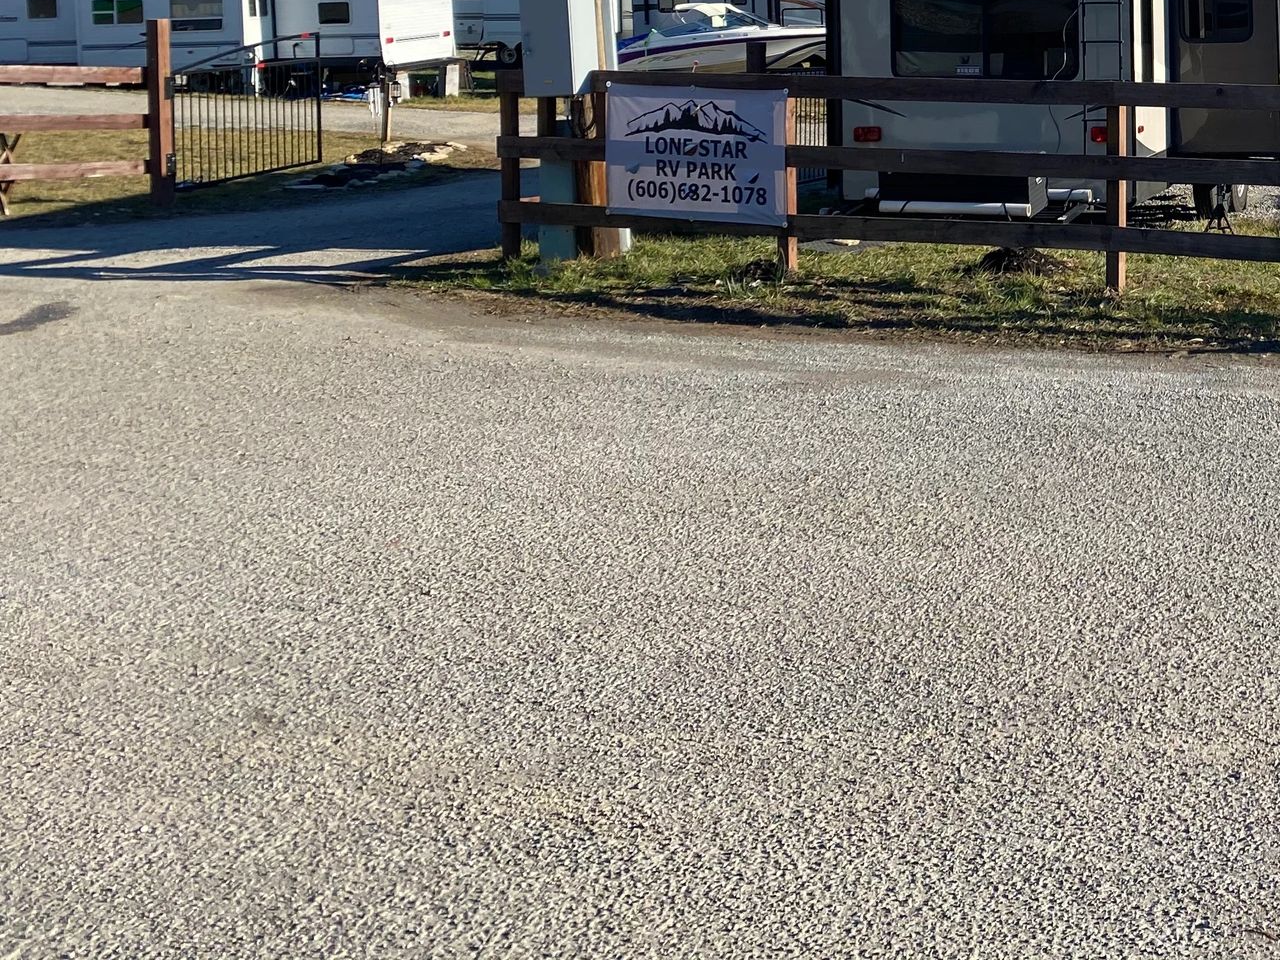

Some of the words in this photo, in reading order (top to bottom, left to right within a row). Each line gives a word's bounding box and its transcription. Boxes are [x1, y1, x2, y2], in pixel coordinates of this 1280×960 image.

[645, 136, 694, 155] LONE
[699, 141, 748, 159] STAR
[656, 159, 680, 178] RV
[686, 161, 737, 181] PARK
[627, 179, 767, 206] (606)682-1078
